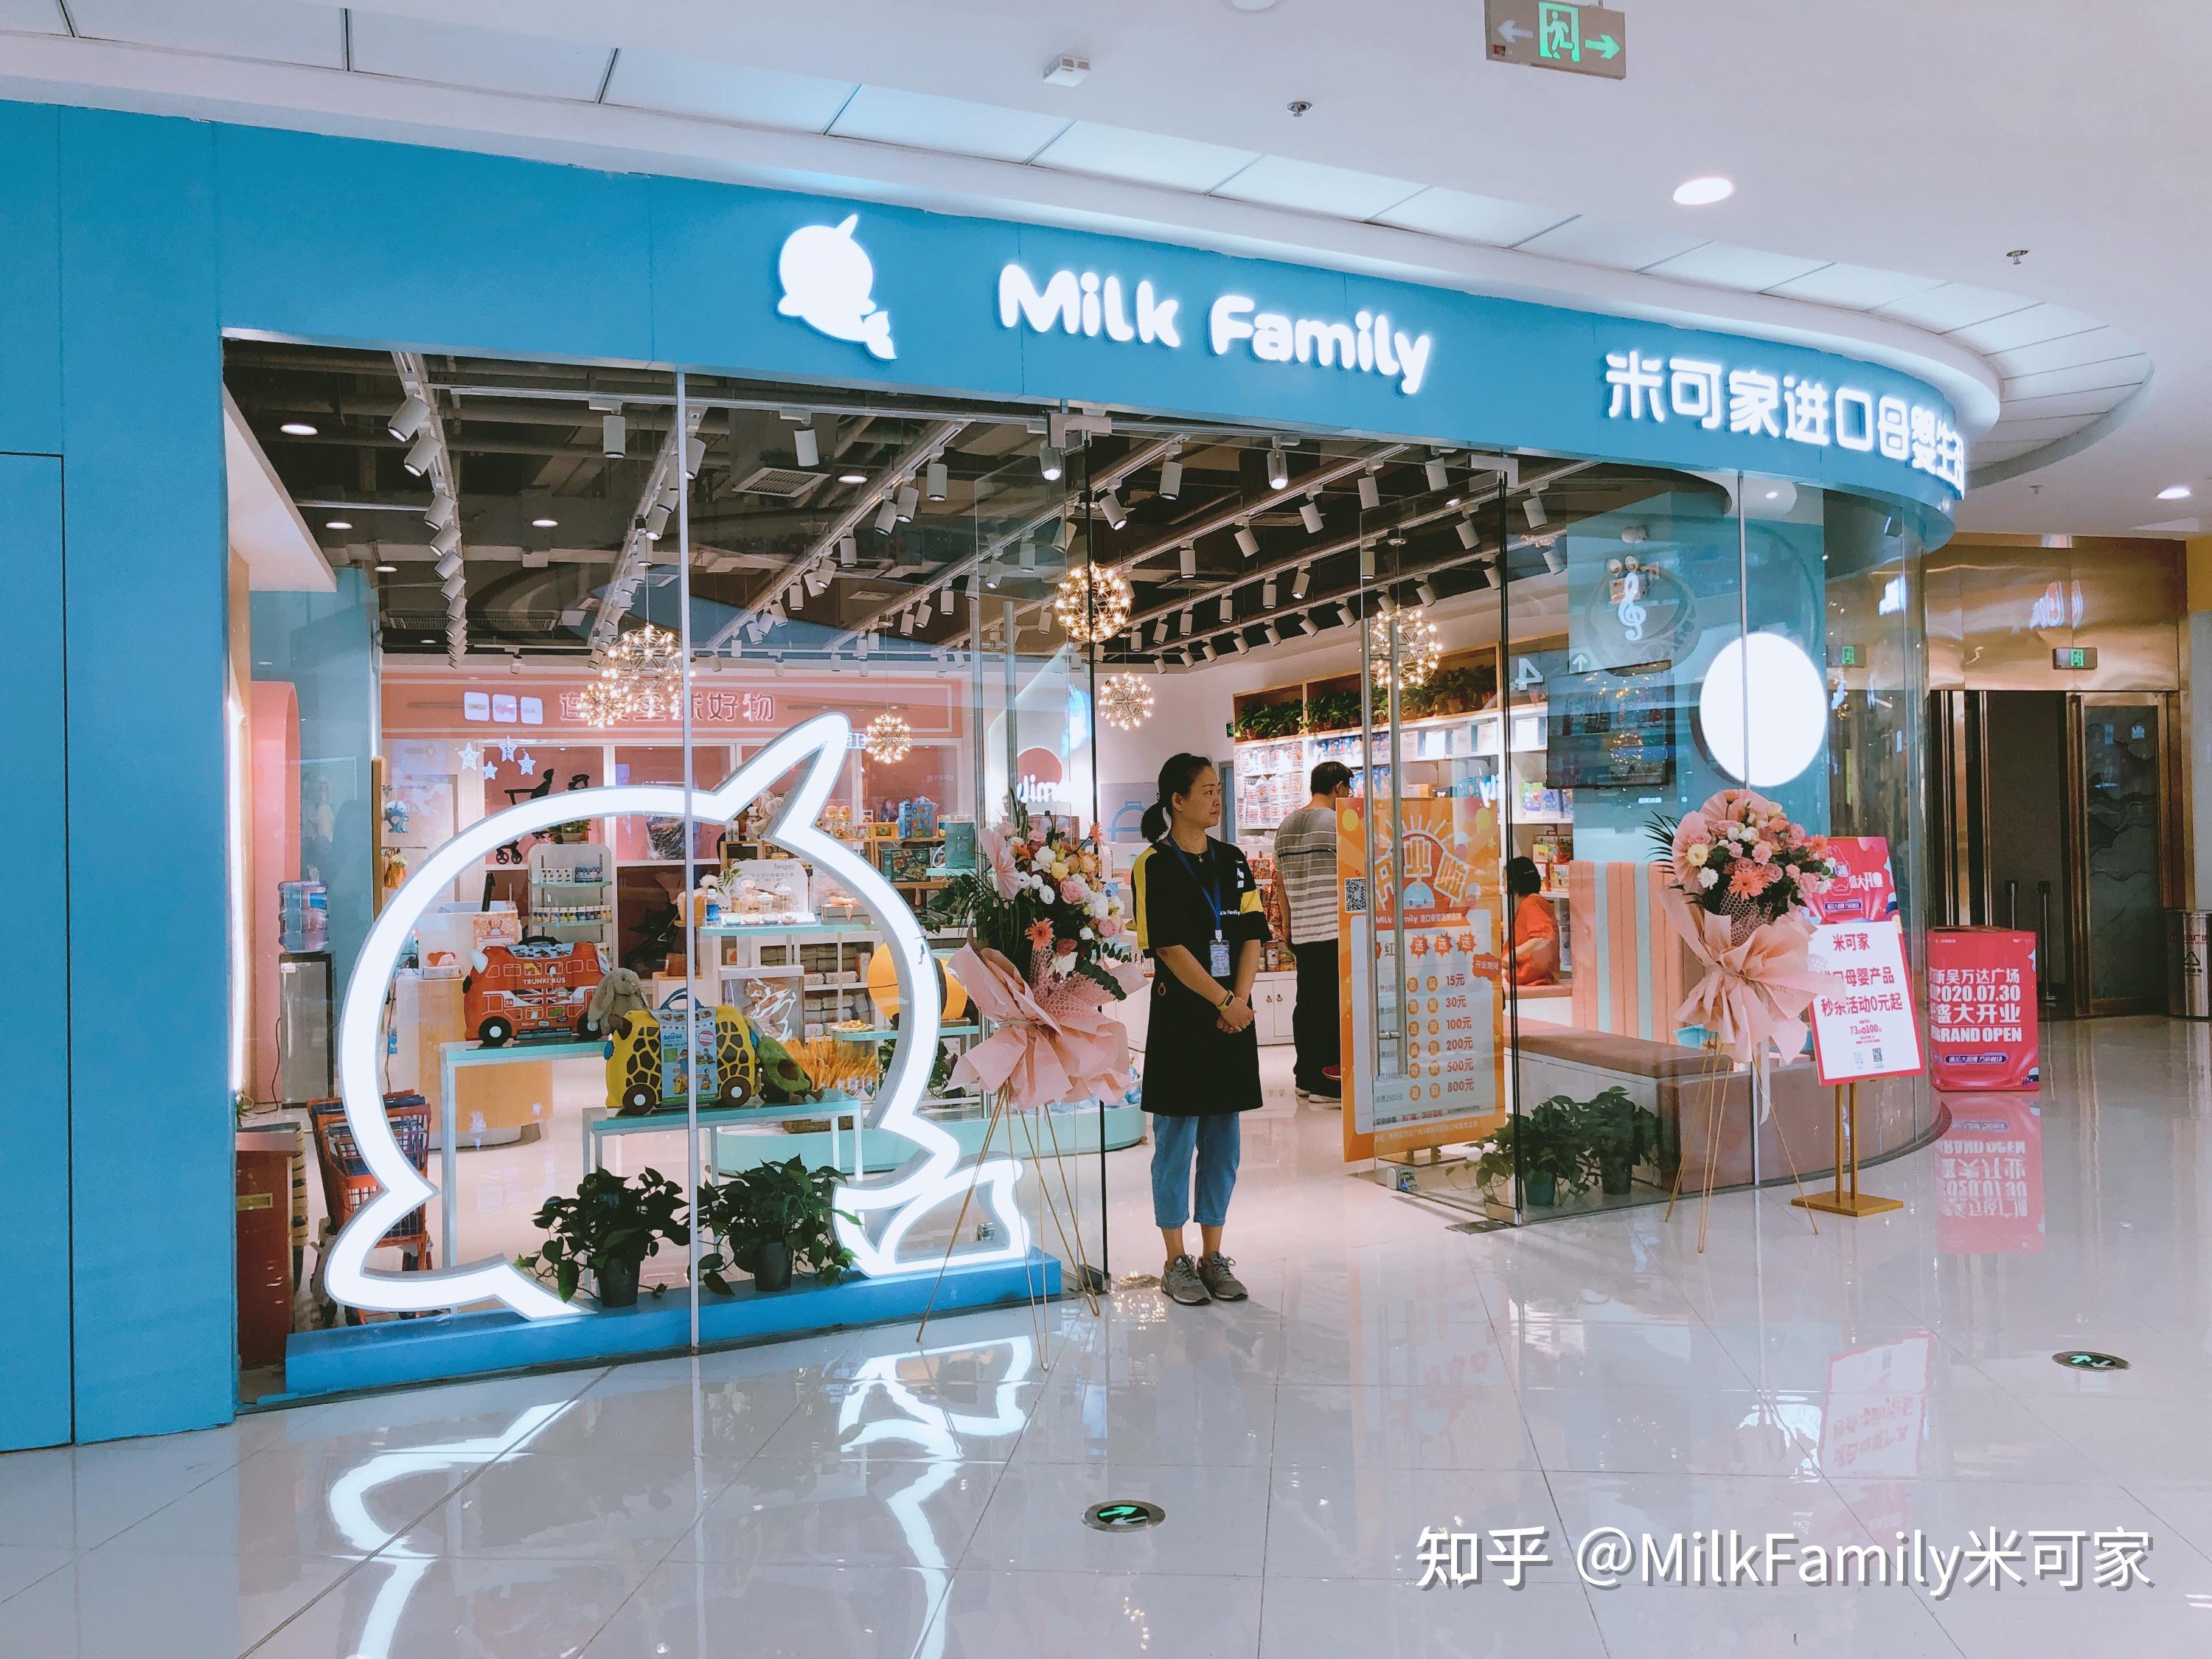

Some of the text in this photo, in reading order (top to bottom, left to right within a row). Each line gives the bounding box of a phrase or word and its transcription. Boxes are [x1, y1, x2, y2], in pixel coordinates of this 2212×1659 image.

[999, 263, 1430, 394] Milk Family
[1833, 933, 1870, 952] 米可家
[1446, 973, 1465, 987] 15元
[1930, 984, 2021, 1003] 2020.07.30
[1445, 995, 1467, 1008] 30元
[1930, 1003, 2021, 1024] 盛大开业
[1446, 1017, 1472, 1030] 100元
[1931, 1026, 2023, 1043] GRAND OPEN
[1446, 1037, 1473, 1051] 200元
[1447, 1058, 1474, 1072] 500元
[1447, 1078, 1474, 1093] 800元
